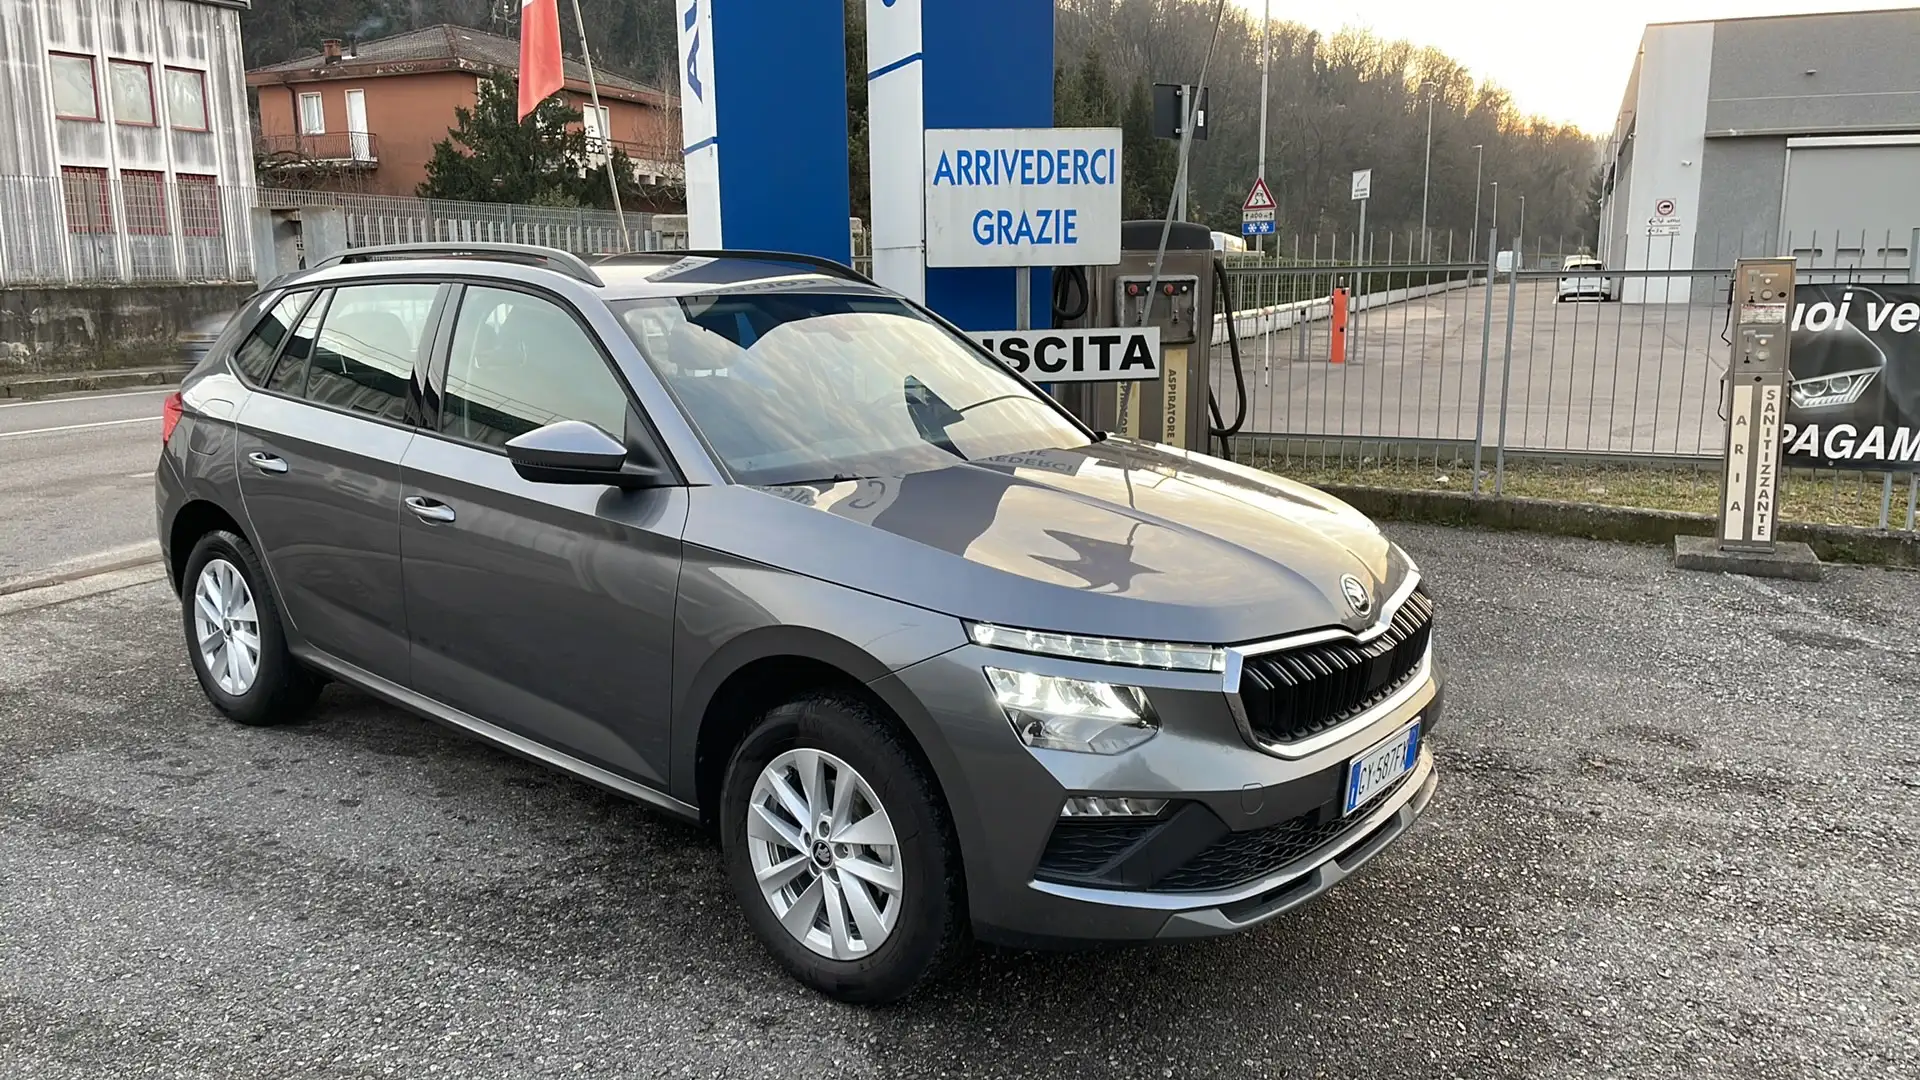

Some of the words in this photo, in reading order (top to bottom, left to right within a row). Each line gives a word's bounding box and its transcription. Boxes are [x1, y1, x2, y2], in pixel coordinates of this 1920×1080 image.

[933, 148, 1116, 186] ARRIVEDERCI
[972, 209, 1078, 246] GRAZIE
[983, 335, 1156, 373] SCITA
[1167, 369, 1177, 437] ASPIRATORE
[1730, 415, 1748, 511] ARIA
[1757, 389, 1776, 536] SANITIZZANTE
